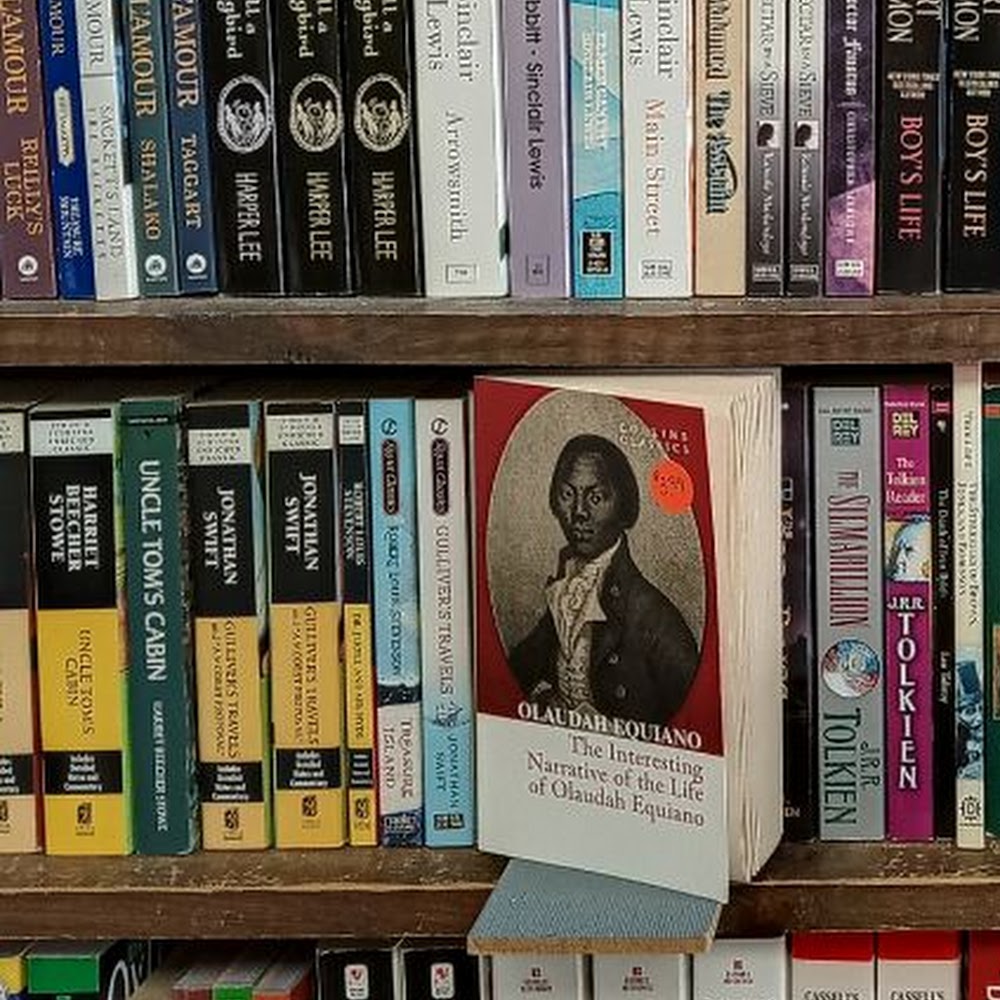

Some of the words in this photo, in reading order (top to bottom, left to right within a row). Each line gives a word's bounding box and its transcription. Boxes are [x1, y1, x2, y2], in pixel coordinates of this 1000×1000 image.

[244, 23, 255, 35] a
[179, 134, 202, 229] TAGGART
[445, 111, 469, 242] Arrowsmith
[898, 116, 924, 185] BOY'S
[234, 171, 260, 234] HARPER
[898, 193, 921, 241] LIFE
[239, 235, 262, 263] LEE
[139, 459, 162, 533] UNCLE
[837, 470, 864, 489] THE
[886, 471, 926, 488] Tolkien
[895, 455, 916, 470] The
[50, 493, 65, 564] STOWE
[66, 484, 81, 573] BEECHER
[81, 484, 100, 571] HARRIET
[286, 498, 301, 555] SWIFT
[299, 472, 320, 572] JONATHAN
[886, 489, 927, 505] Reader
[141, 539, 164, 606] TOM'S
[435, 526, 452, 620] GULLIVER'S
[827, 494, 871, 629] SILMARILLION
[887, 596, 925, 611] J.R.R.
[145, 607, 168, 682] CABIN
[437, 623, 455, 695] TRAVELS
[518, 702, 609, 734] OLAUDAH
[611, 716, 703, 749] EQUIANO
[896, 612, 917, 790] TOLKIEN
[527, 752, 609, 783] Narrative
[613, 767, 633, 790] of
[636, 770, 665, 794] the
[670, 777, 705, 803] Life
[571, 736, 604, 758] The
[607, 742, 706, 785] Interesting
[823, 708, 861, 826] TOLKIEN
[528, 778, 549, 797] of
[551, 779, 627, 812] Olaudah
[632, 795, 706, 828] Equiano
